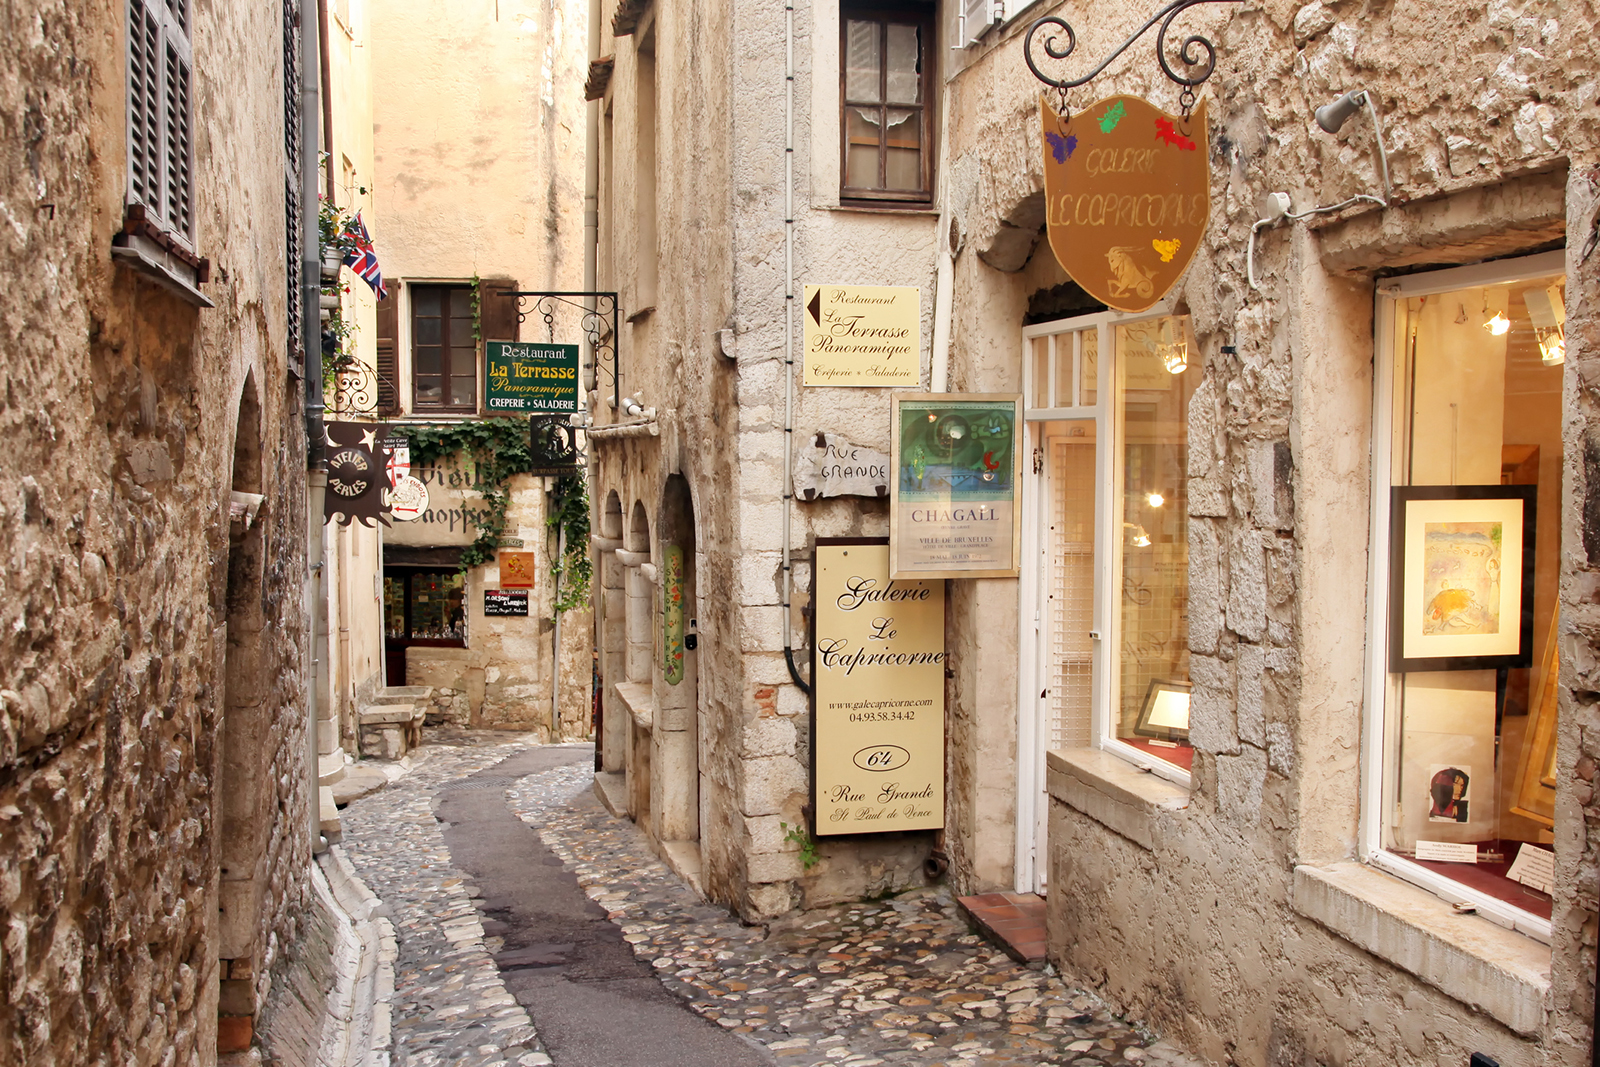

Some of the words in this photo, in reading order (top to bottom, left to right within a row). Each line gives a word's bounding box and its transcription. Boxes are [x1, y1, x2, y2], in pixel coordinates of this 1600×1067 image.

[1049, 193, 1074, 227] LE
[830, 289, 897, 305] Restaurant
[823, 308, 842, 323] La
[830, 316, 910, 338] Terrasse
[501, 344, 567, 359] Restaurant
[811, 334, 911, 360] Panoramique
[489, 362, 508, 377] La
[512, 362, 575, 379] Terrasse
[865, 364, 912, 378] Saladerie
[491, 376, 574, 398] Panoramique
[490, 398, 525, 408] CREPERIE
[533, 399, 574, 409] SALADERIE
[330, 451, 368, 471] ATELIER
[823, 444, 858, 461] RUE
[821, 464, 886, 480] GRANDE
[328, 478, 367, 496] PERLES
[912, 508, 999, 522] CHAGALL
[836, 576, 930, 611] Galerie
[869, 617, 897, 640] Le
[818, 638, 945, 676] Capricorne
[829, 698, 933, 710] www.galecapricorne.com
[849, 711, 915, 722] 04.93.58.34.42
[866, 751, 893, 767] 64
[830, 785, 866, 803] Rue
[876, 782, 934, 804] Grande
[830, 808, 850, 822] St
[854, 807, 886, 820] Paul
[887, 809, 898, 819] de
[903, 804, 932, 819] Vence
